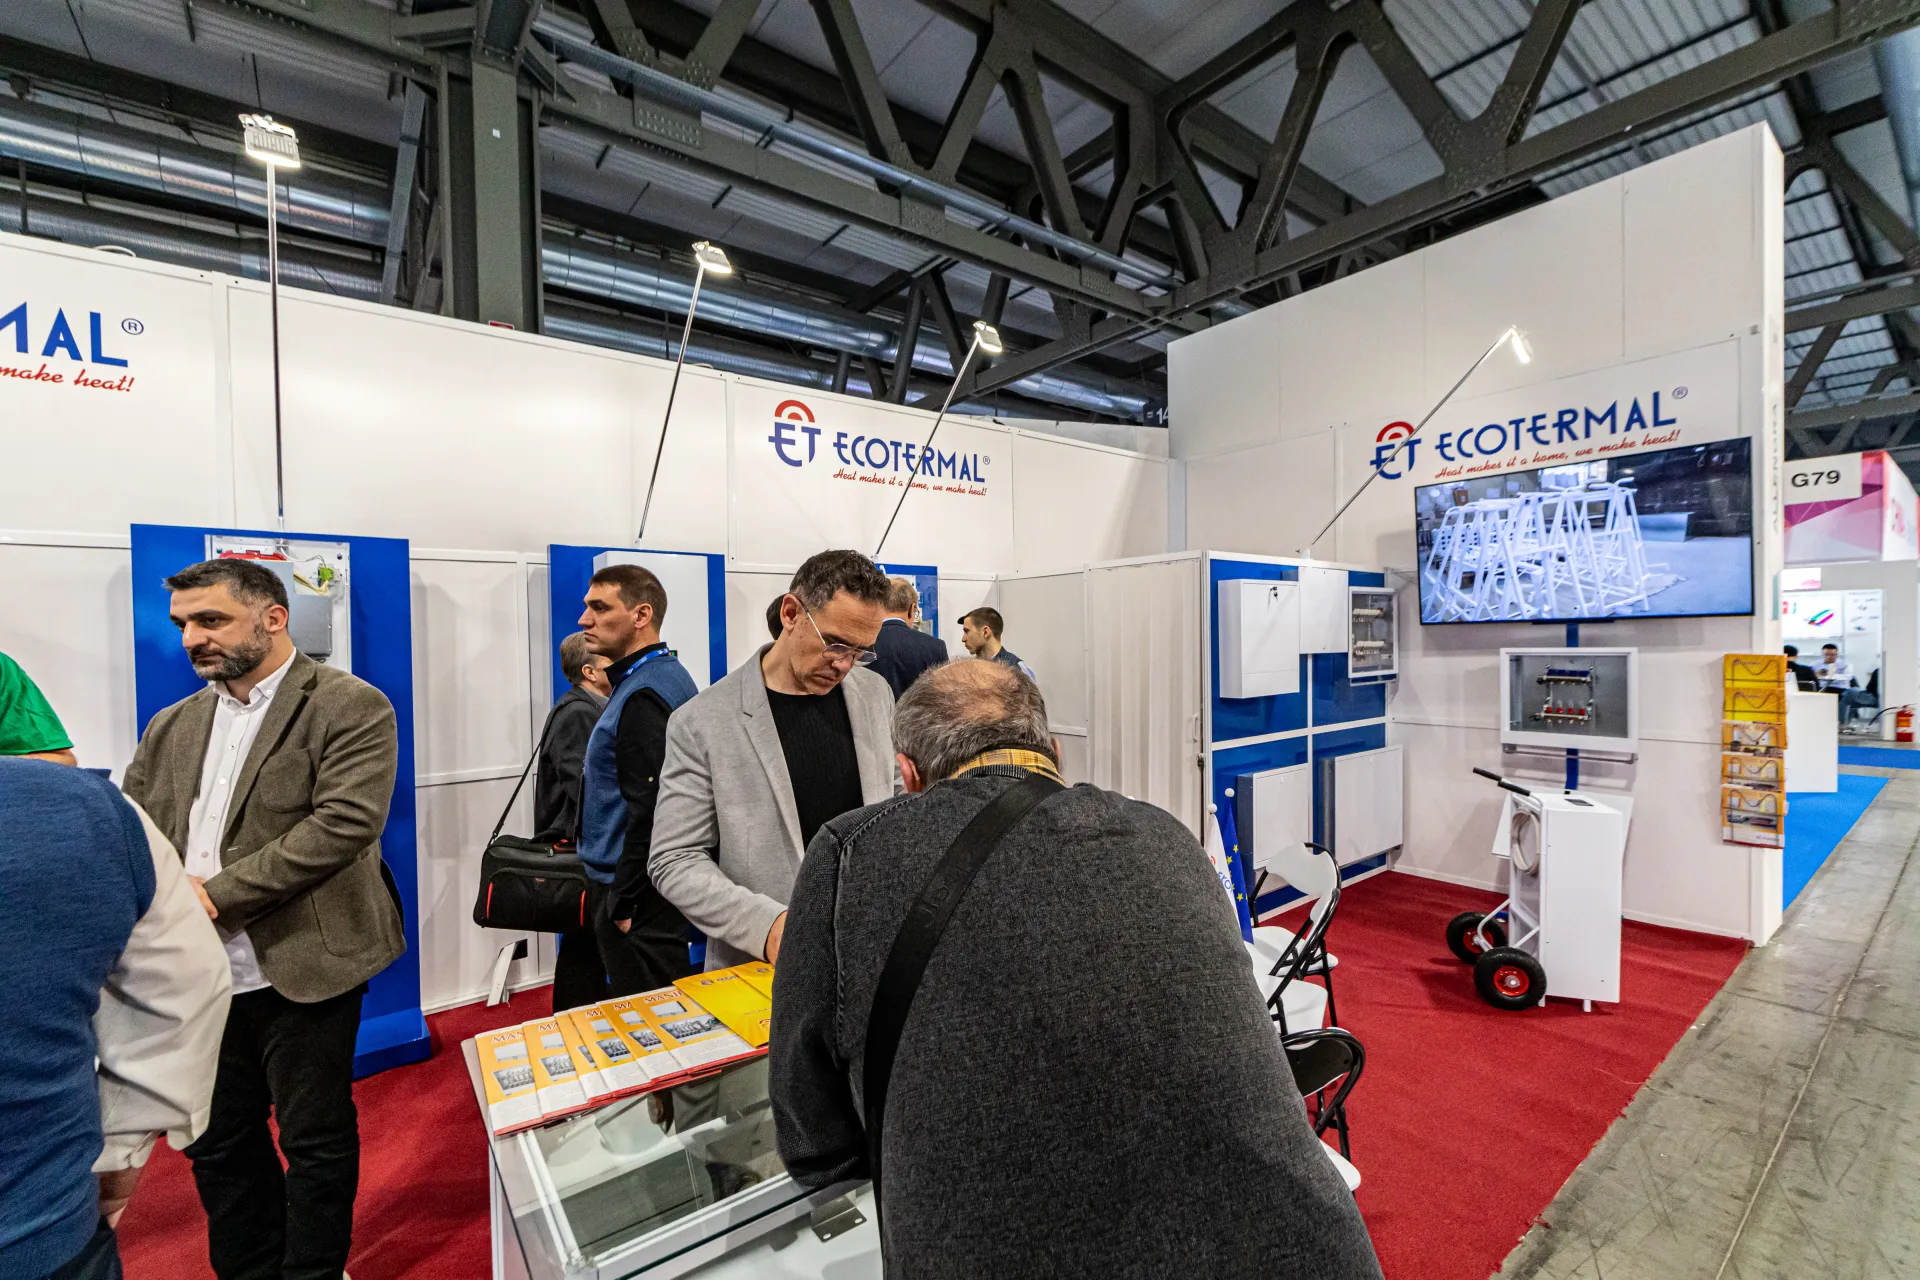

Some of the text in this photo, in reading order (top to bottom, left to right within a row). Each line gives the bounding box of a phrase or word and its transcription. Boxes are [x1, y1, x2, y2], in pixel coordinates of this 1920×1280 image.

[74, 369, 135, 392] heat!
[768, 422, 821, 467] ET
[1370, 438, 1422, 480] ET
[1435, 429, 1681, 479] Heat makes it a home, we make heat!
[833, 468, 857, 481] Heat
[859, 473, 886, 485] makes
[889, 475, 896, 486] it
[946, 484, 966, 495] make
[968, 486, 987, 497] heat!
[1791, 470, 1841, 488] G79
